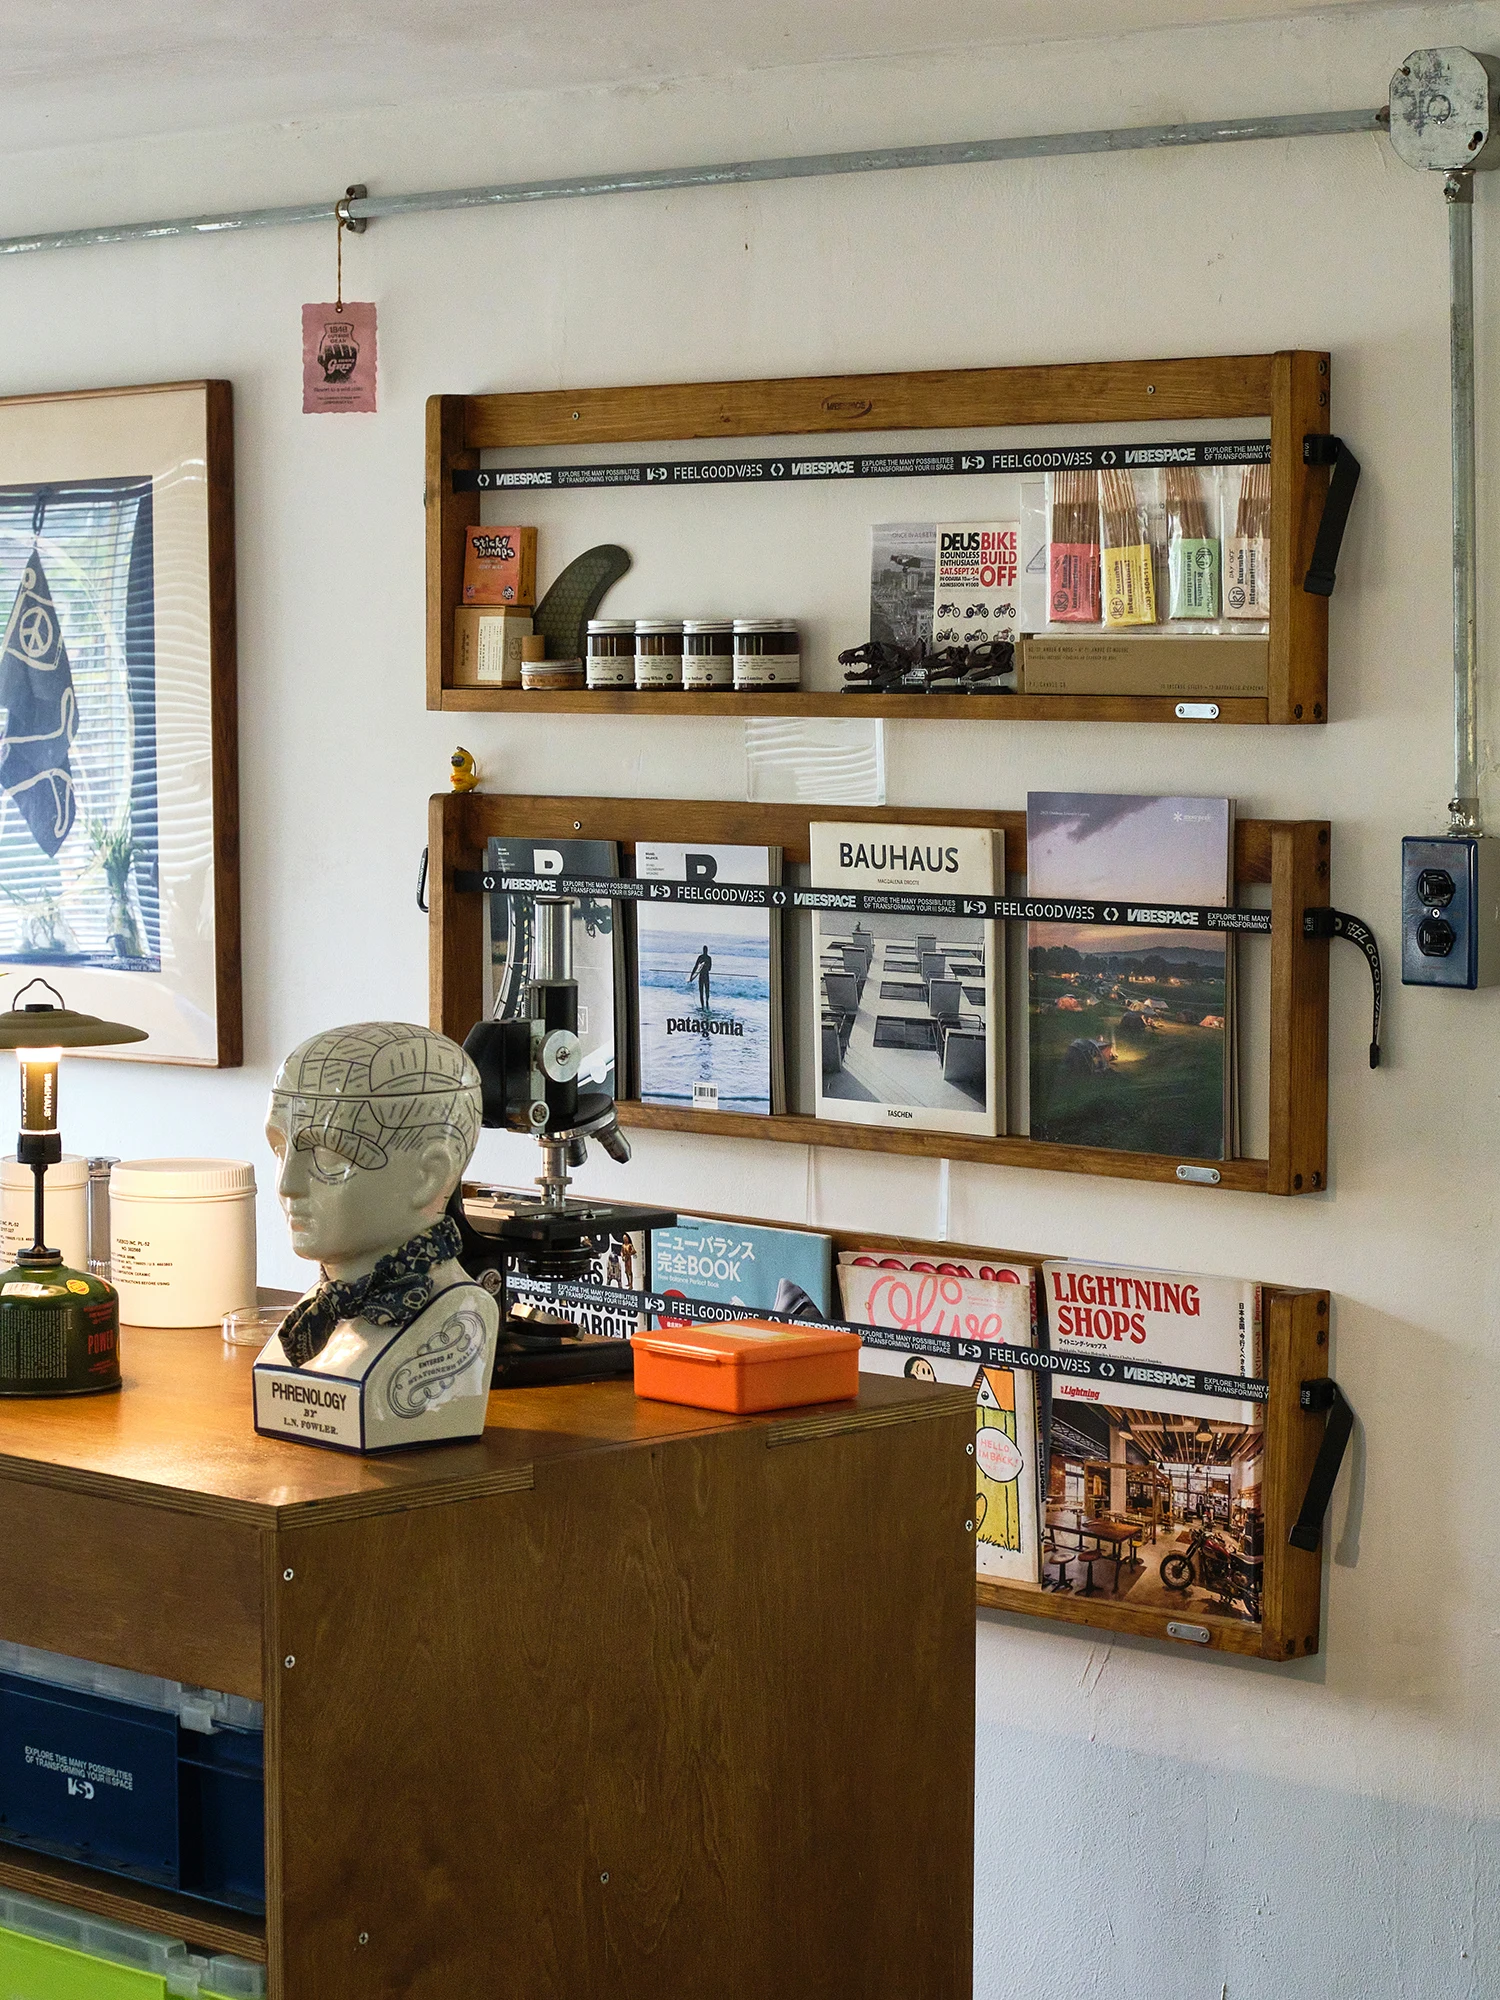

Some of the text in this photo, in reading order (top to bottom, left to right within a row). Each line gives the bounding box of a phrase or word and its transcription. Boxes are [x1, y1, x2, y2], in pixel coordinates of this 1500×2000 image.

[916, 456, 954, 464] POSSIBILITIES
[1124, 448, 1196, 464] VIBESPACE
[1214, 452, 1263, 460] TRANSFORMING
[792, 460, 854, 476] VIBESPACE
[870, 464, 914, 472] TRANSFORMING
[496, 472, 552, 486] VIBESPACE
[472, 536, 510, 548] sticky
[941, 532, 980, 550] DEUS
[981, 532, 1017, 550] BIKE
[479, 546, 516, 560] bumps
[980, 552, 1017, 564] BUILD
[980, 566, 1017, 587] OFF
[1124, 560, 1134, 614] International
[840, 842, 959, 873] BAUHAUS
[502, 878, 556, 892] VIBESPACE
[794, 892, 856, 908] VIBESPACE
[872, 903, 916, 912] TRANSFORMING
[918, 898, 956, 906] POSSIBILITIES
[1127, 908, 1199, 925] VIBESPACE
[1207, 912, 1236, 921] EXPLORE
[1218, 920, 1268, 929] TRANSFORMING
[666, 1016, 744, 1038] patagonia
[888, 1110, 912, 1118] TASCHEN
[658, 1231, 756, 1261] ニューバランス
[658, 1250, 742, 1282] 完全BOOK
[506, 1275, 552, 1294] BESPACE
[557, 1284, 638, 1302] EXPLORE THE MANY POSSIBILITIES
[565, 1292, 603, 1303] TRANSFORMING
[622, 1300, 638, 1308] SPACE
[1052, 1272, 1200, 1316] LIGHTNING
[1058, 1304, 1146, 1345] SHOPS
[858, 1328, 950, 1348] EXPLORE THE MANY POSSIBILITIES
[867, 1337, 909, 1349] TRANSFORMING
[910, 1344, 927, 1352] YOUR
[932, 1345, 950, 1354] SPACE
[418, 1356, 444, 1368] ENTERED
[1123, 1366, 1196, 1388] VIBESPACE
[1204, 1377, 1264, 1392] EXPLORE THE MANY
[272, 1382, 346, 1411] PHRENOLOGY
[1064, 1386, 1100, 1400] Lightning
[1214, 1385, 1263, 1399] TRANSFORMING
[304, 1409, 318, 1418] BY
[301, 1420, 338, 1435] FOWLER.
[24, 1746, 133, 1783] EXPLORE THE MANY POSSIBILITIES
[25, 1755, 134, 1791] OF TRANSFORMING YOUR SPACE
